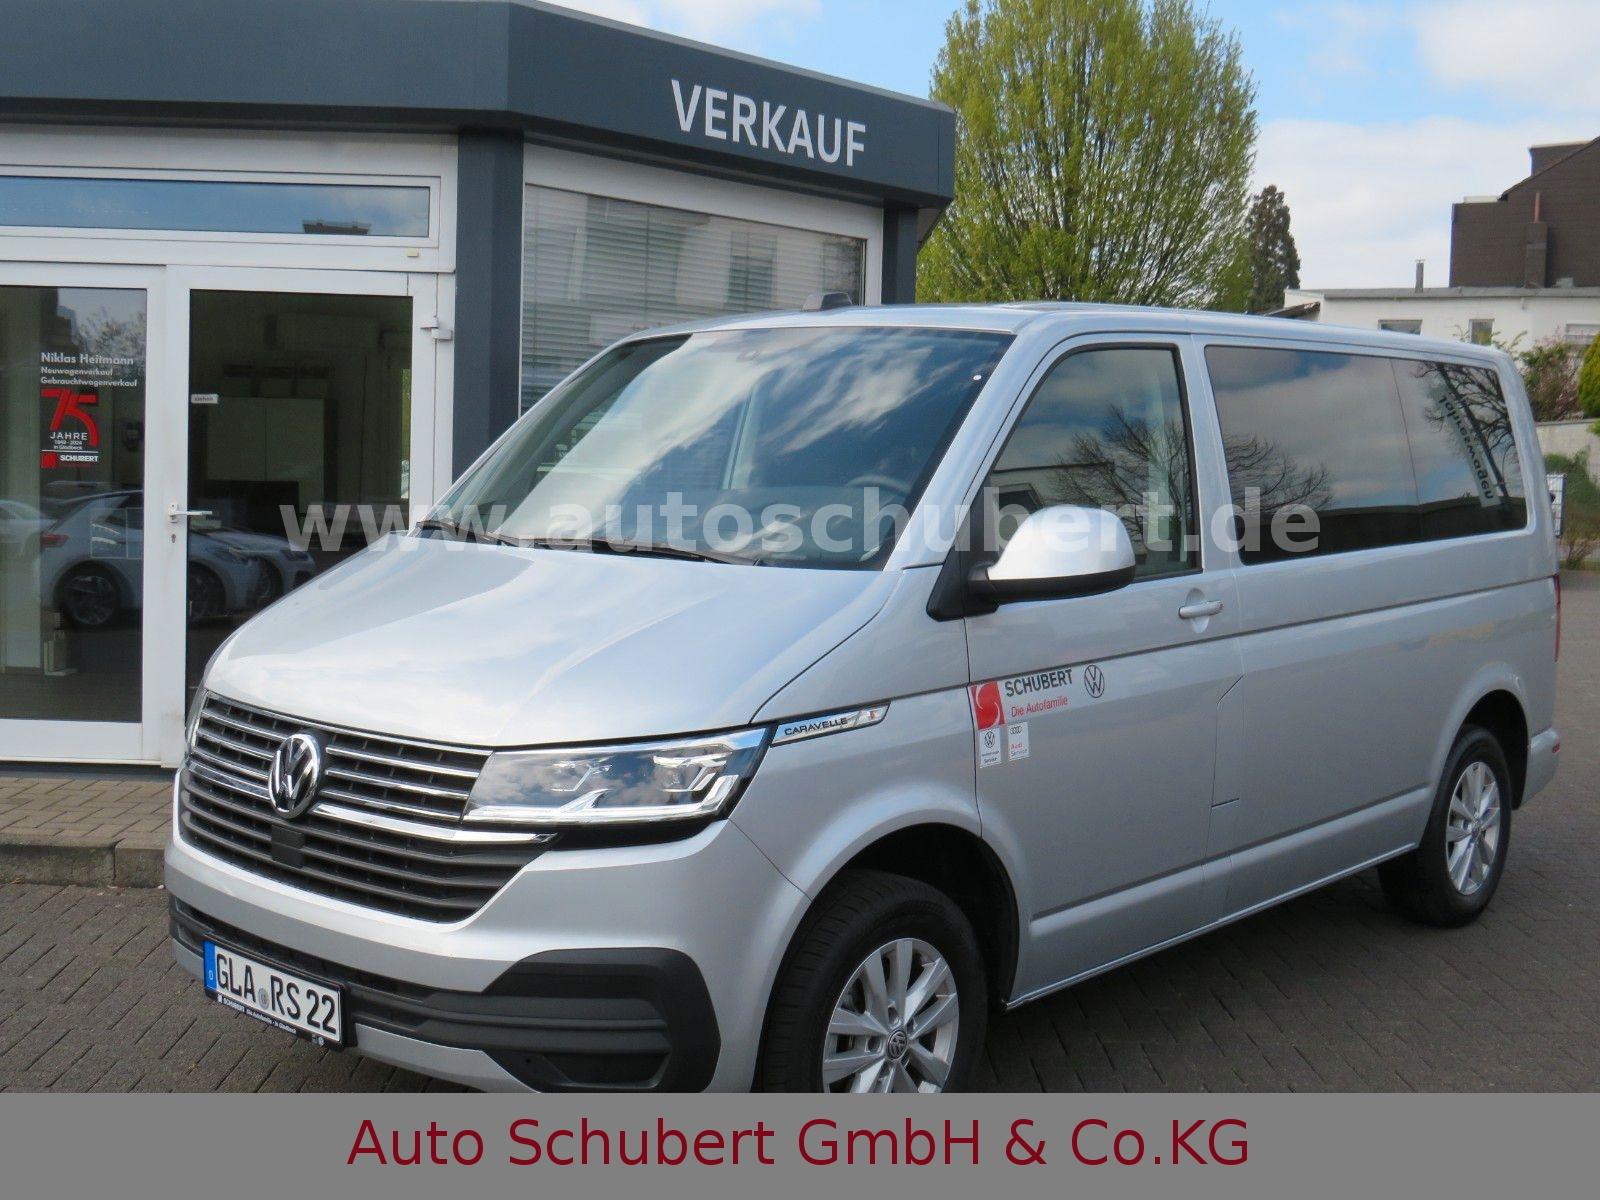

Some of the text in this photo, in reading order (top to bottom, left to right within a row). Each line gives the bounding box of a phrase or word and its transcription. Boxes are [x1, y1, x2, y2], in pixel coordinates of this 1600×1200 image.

[671, 79, 866, 167] VERKAUF
[41, 352, 76, 364] Niklas
[50, 432, 88, 441] JAHRE
[60, 454, 99, 462] SCHUBERT
[1004, 668, 1073, 698] SCHUBERT
[1011, 696, 1069, 717] Die Autofamilie
[784, 717, 848, 736] CARAVELLE
[216, 953, 337, 1034] GLA RS 22
